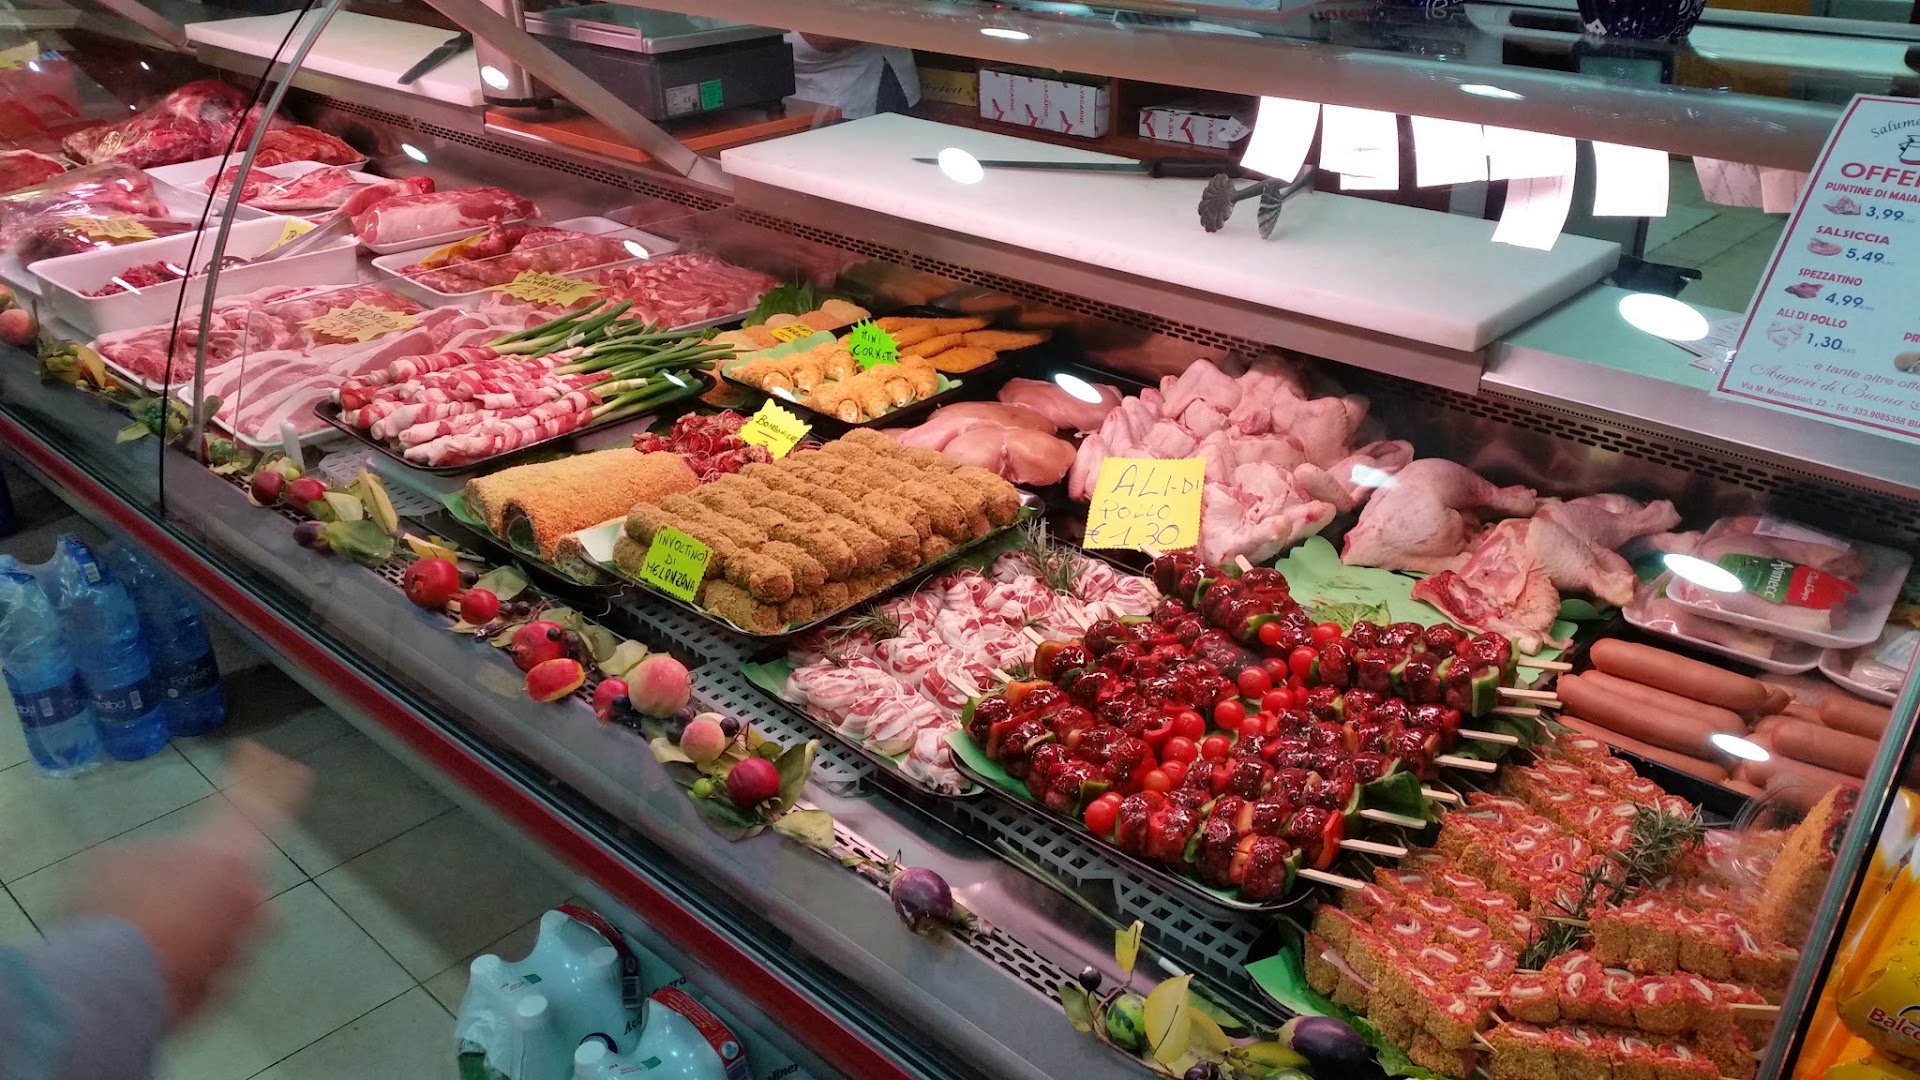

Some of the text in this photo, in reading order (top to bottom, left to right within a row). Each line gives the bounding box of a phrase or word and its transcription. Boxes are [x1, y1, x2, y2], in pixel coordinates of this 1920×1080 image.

[1825, 181, 1920, 203] PUNTINE DI MAIA
[1865, 206, 1905, 221] 3,99
[1816, 225, 1890, 245] SALSICCIA
[1845, 247, 1885, 263] 5,49
[1798, 267, 1863, 287] SPEZZATINO
[1825, 292, 1864, 308] 4,99
[1776, 308, 1848, 329] ALI DI POLLO
[1806, 332, 1843, 350] 1,30
[1826, 364, 1860, 379] tante
[1863, 374, 1894, 386] altre
[1741, 380, 1753, 391] Via
[1815, 398, 1827, 408] 22
[1099, 499, 1170, 520] POLLO
[664, 553, 677, 565] DI
